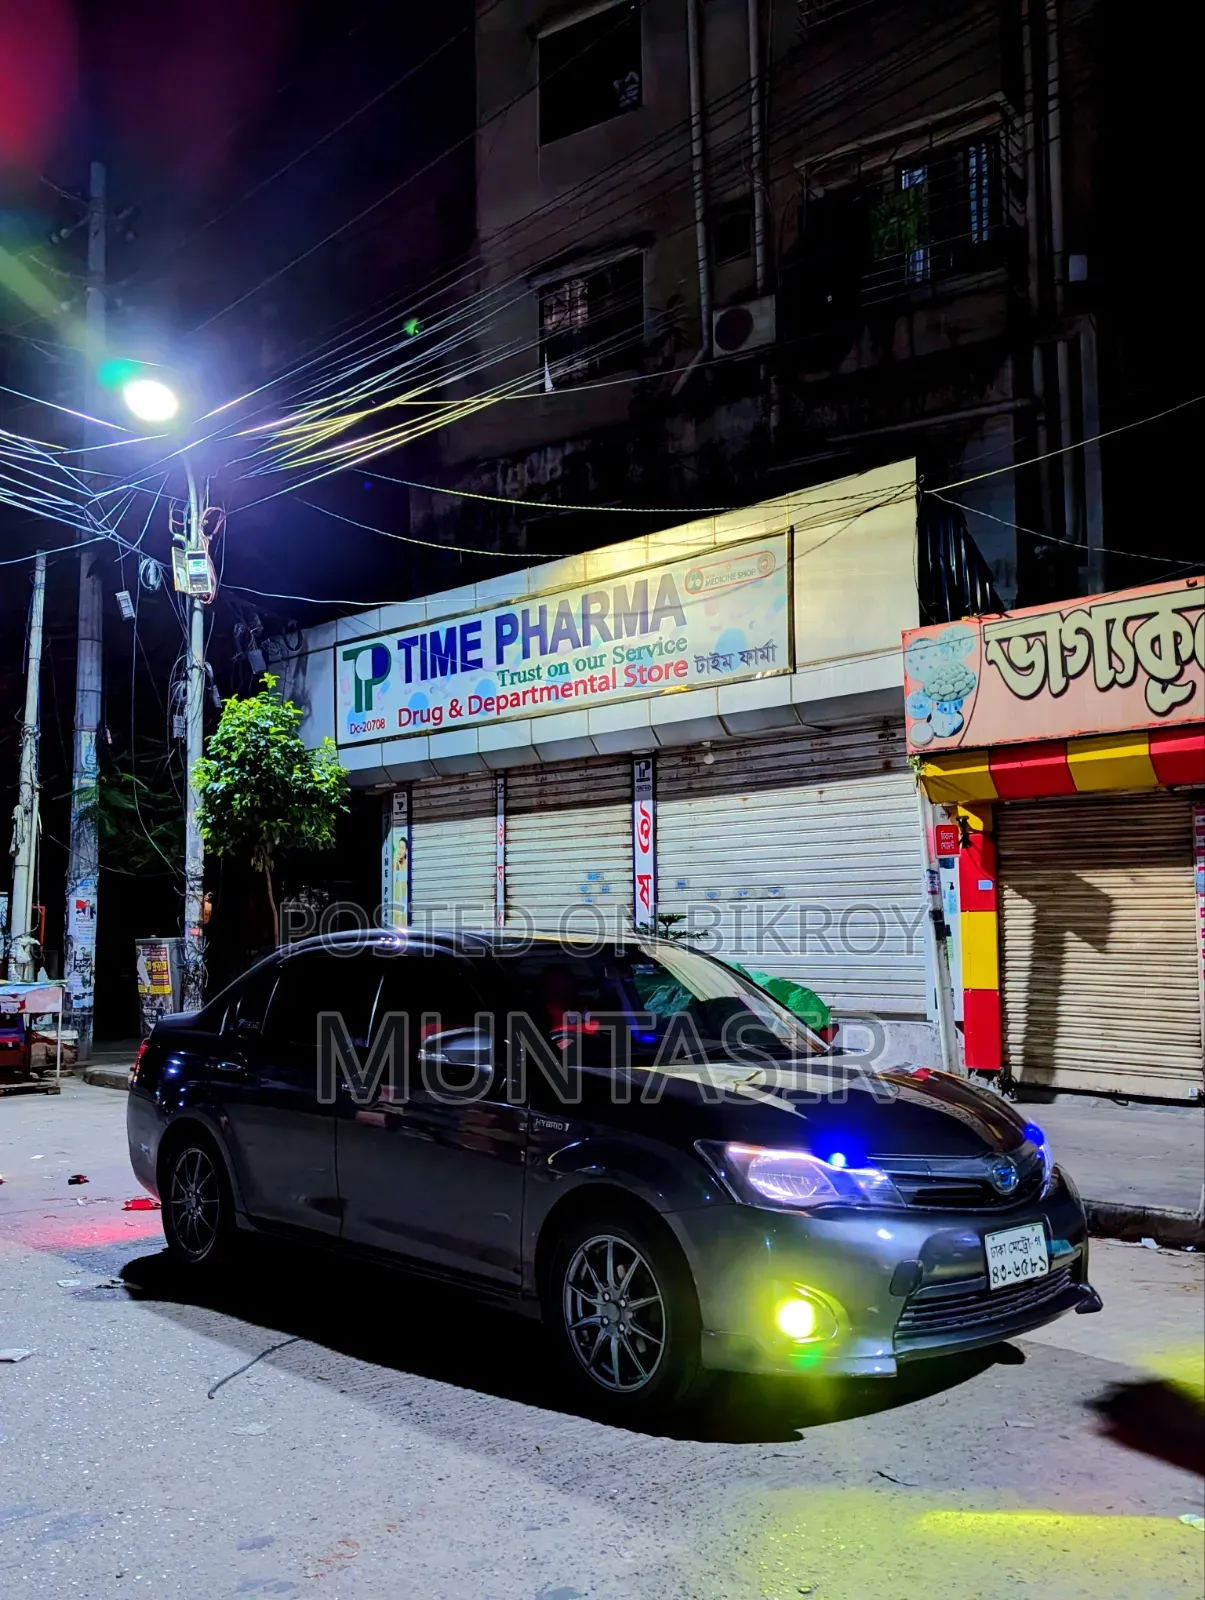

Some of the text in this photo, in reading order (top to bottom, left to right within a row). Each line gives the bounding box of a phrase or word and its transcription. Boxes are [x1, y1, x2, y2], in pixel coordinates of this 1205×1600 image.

[737, 568, 756, 578] SHOP
[397, 573, 687, 684] TIME PHARMA
[497, 636, 689, 687] Trust on our Service
[694, 638, 778, 674] টাইম ফার্মা
[398, 659, 689, 727] Drug & Departmental Store
[350, 718, 386, 735] Dc-20708
[535, 1118, 563, 1131] HYBRID
[990, 1243, 1007, 1258] ঢাকা
